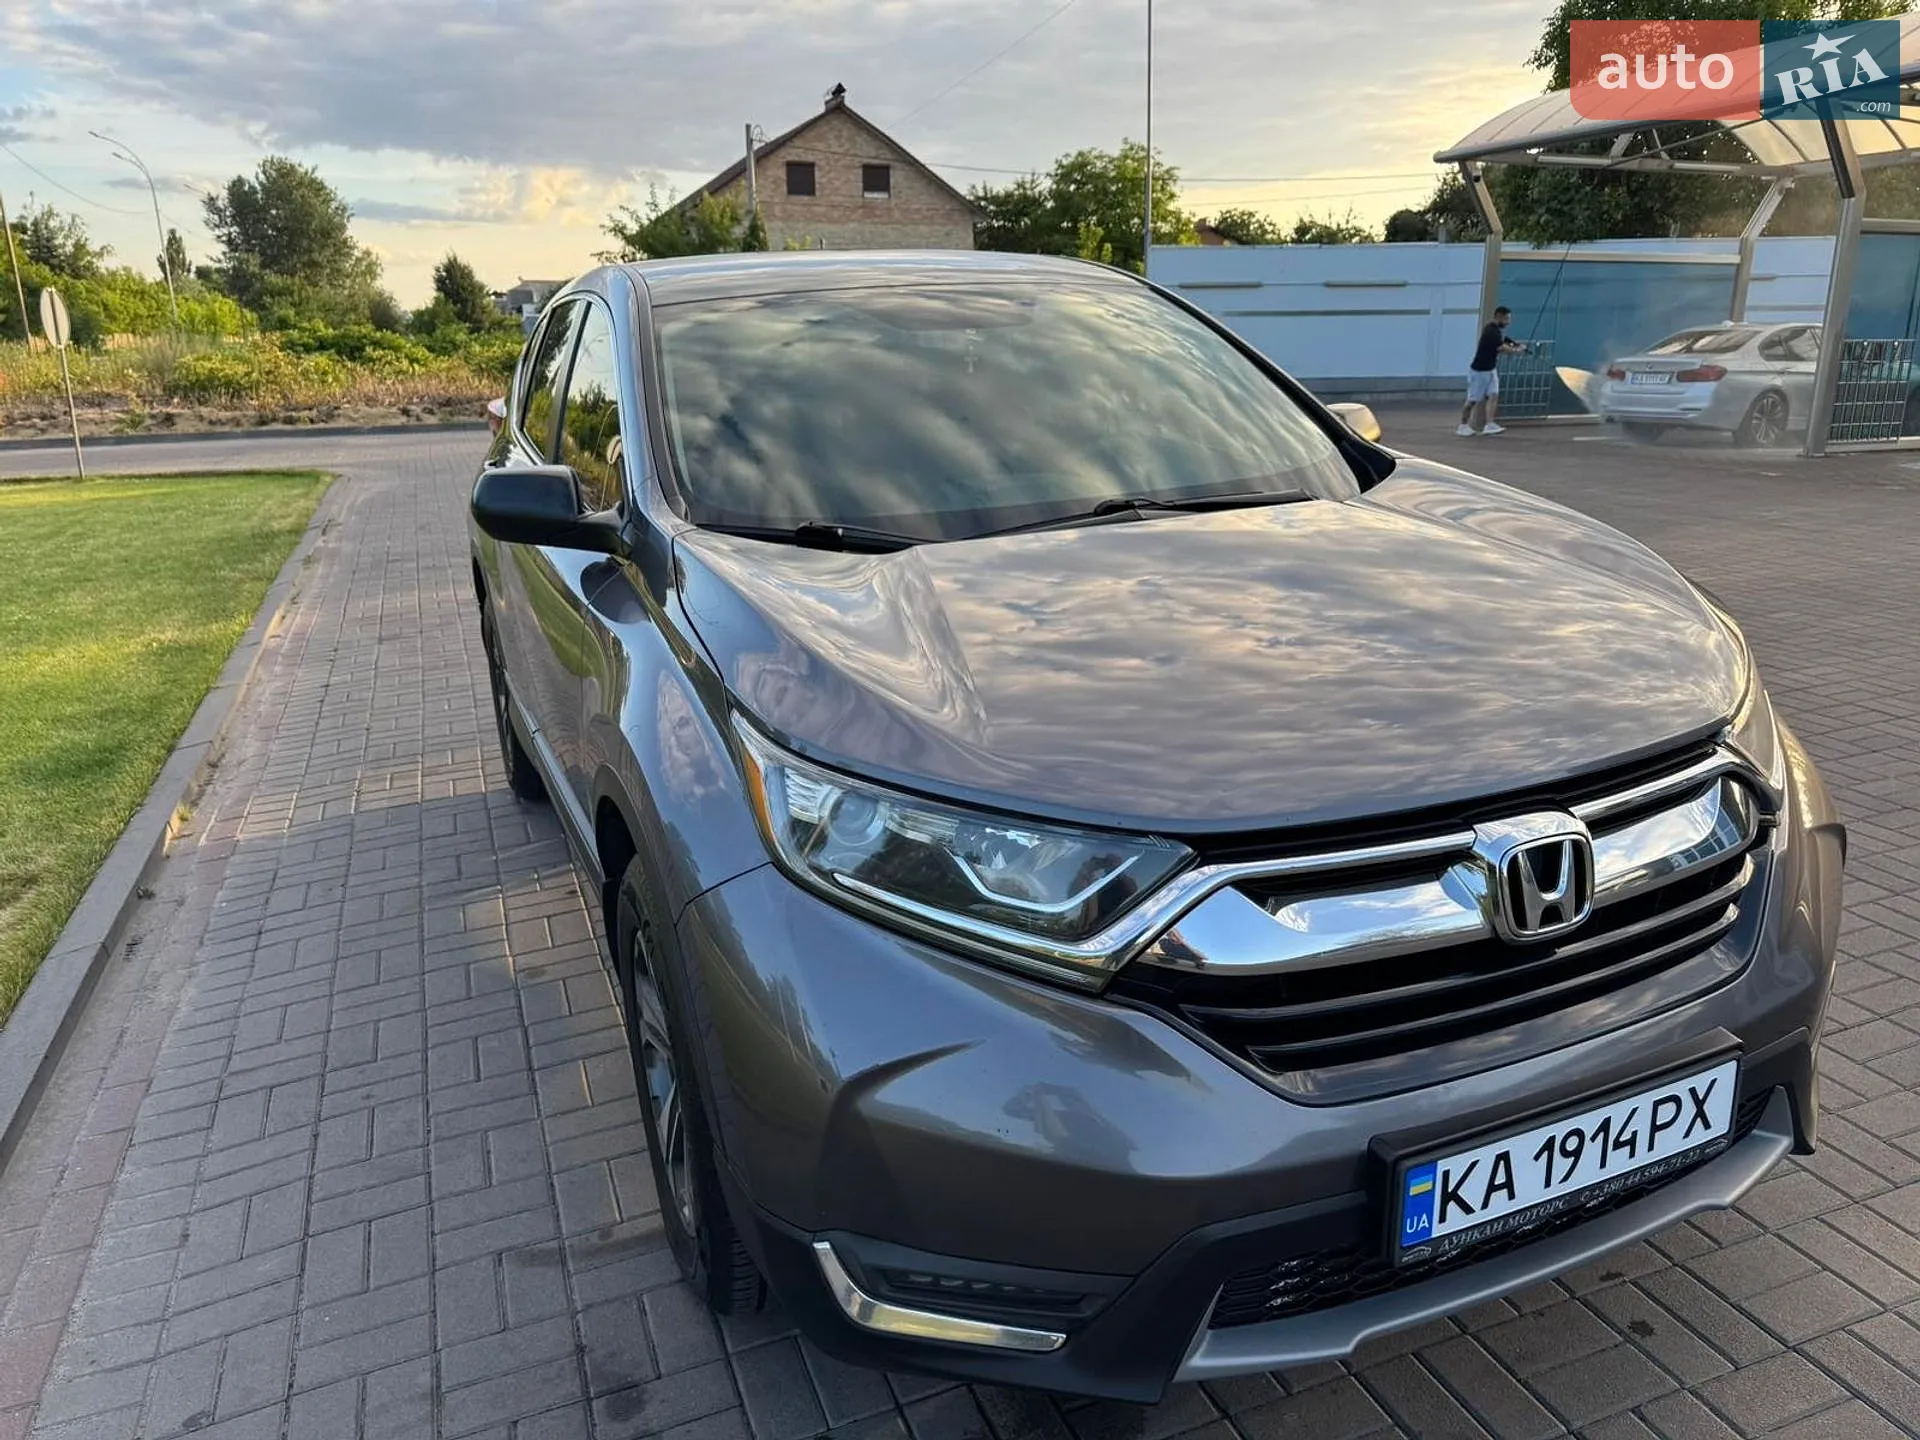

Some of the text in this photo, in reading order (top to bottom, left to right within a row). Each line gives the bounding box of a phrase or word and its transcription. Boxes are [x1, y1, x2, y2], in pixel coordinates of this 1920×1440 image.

[1438, 1150, 1516, 1225] KA
[1532, 1106, 1640, 1190] 1914
[1406, 1212, 1430, 1234] UA
